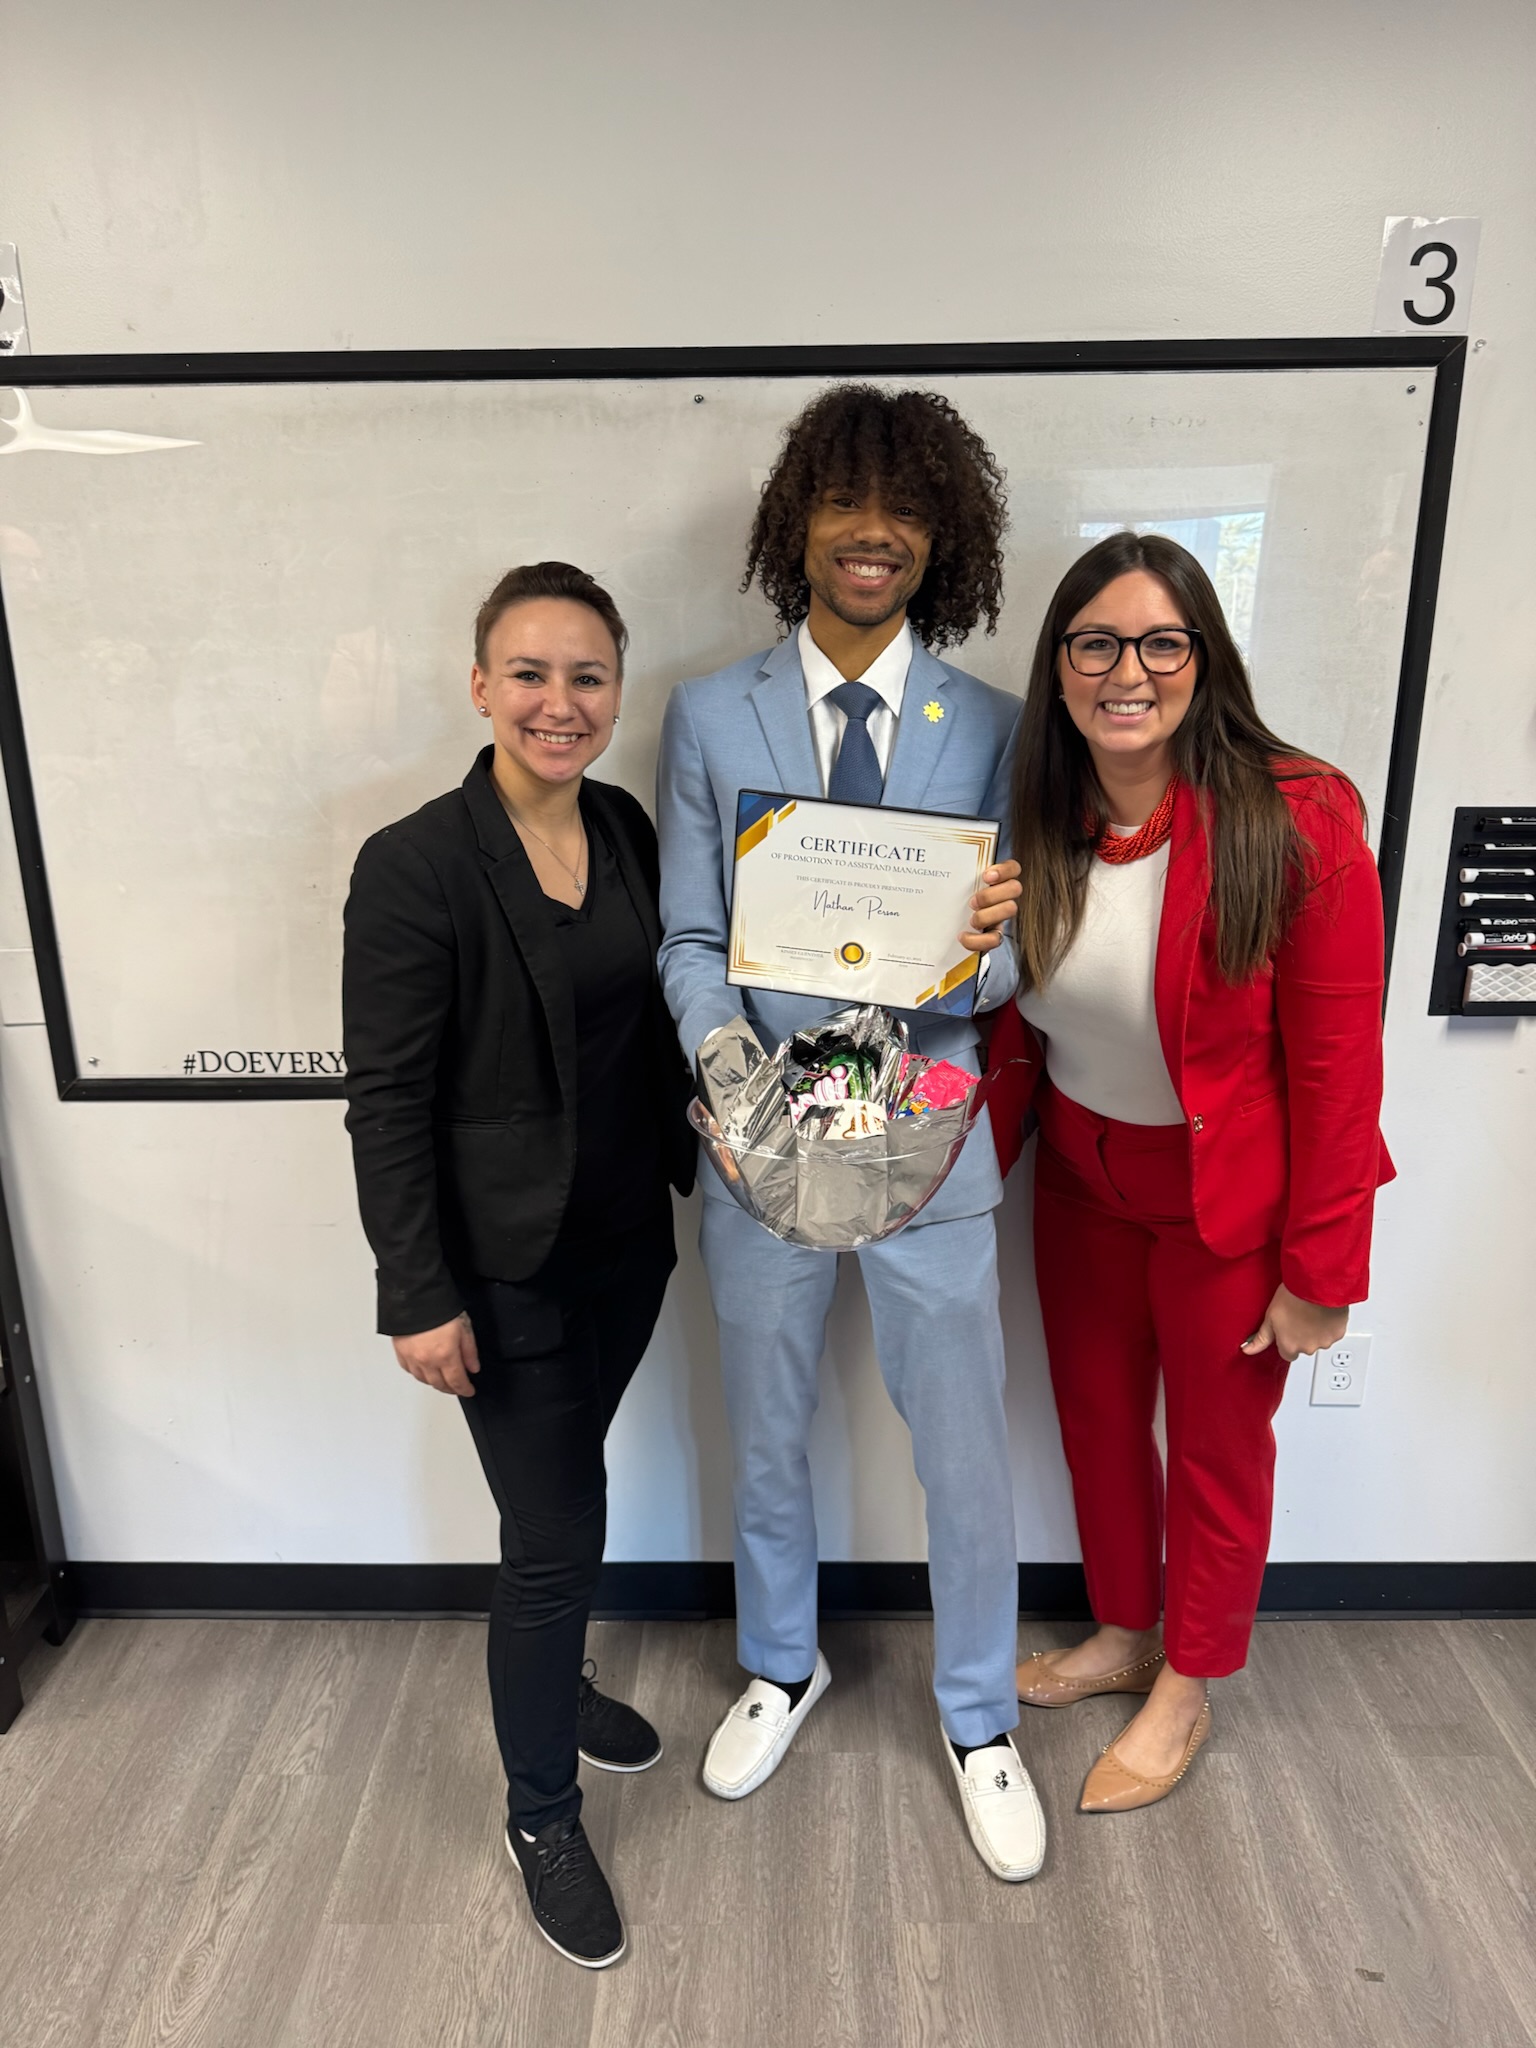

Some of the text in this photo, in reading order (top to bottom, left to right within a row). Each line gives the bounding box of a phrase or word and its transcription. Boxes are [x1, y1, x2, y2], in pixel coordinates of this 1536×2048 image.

[1403, 241, 1458, 325] 3
[800, 836, 926, 863] CERTIFICATE
[783, 853, 833, 865] PROMOTION
[835, 859, 847, 867] TO
[847, 861, 891, 872] ASSISTAND
[892, 865, 951, 879] MANAGEMENT
[809, 876, 847, 886] CERTIFICATE
[854, 881, 880, 890] PROUDLY
[881, 885, 914, 894] PRESENTED
[814, 889, 900, 920] Nathan Person
[183, 1050, 344, 1075] #DOEVERY
